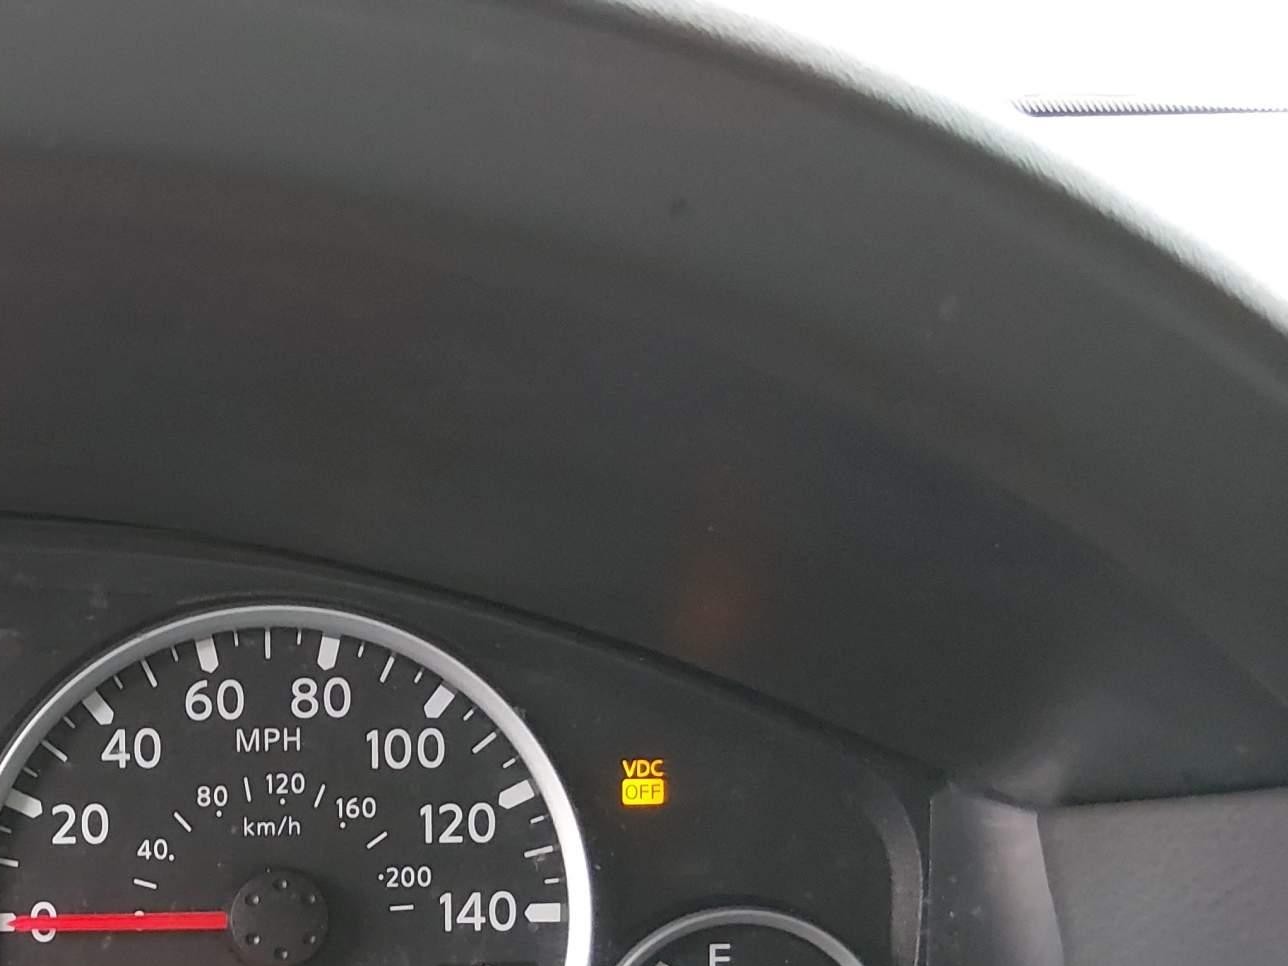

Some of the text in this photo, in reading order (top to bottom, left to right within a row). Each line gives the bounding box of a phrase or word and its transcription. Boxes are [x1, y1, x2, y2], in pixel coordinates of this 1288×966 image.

[186, 680, 244, 720] 60
[291, 678, 350, 718] 80
[102, 728, 161, 768] 40
[237, 728, 300, 752] MPH
[367, 728, 444, 769] 100
[267, 773, 304, 794] 120
[623, 758, 665, 778] VDC
[198, 786, 227, 806] 80
[337, 798, 376, 818] 160
[626, 784, 661, 800] OFF
[52, 804, 108, 844] 20
[244, 816, 300, 836] km/h
[421, 803, 495, 843] 120
[387, 867, 431, 887] 200
[30, 902, 57, 942] 0
[440, 891, 516, 931] 140
